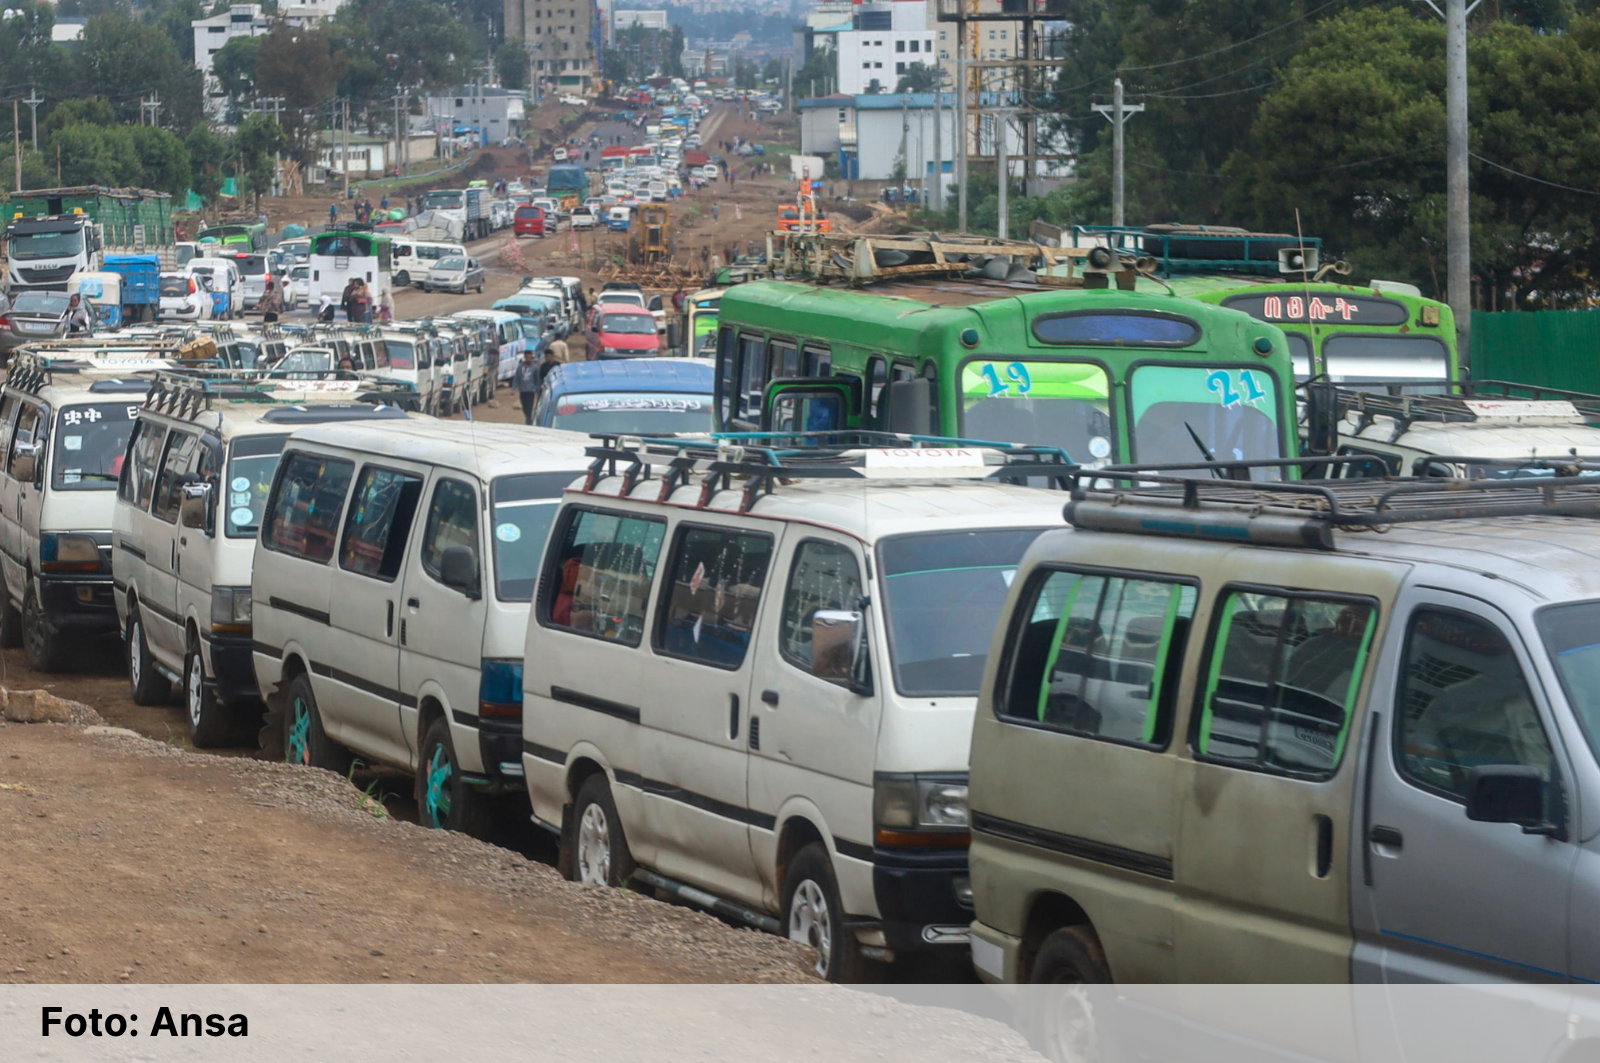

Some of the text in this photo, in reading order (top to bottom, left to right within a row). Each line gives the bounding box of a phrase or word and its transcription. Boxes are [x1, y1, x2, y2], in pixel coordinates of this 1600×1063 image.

[981, 361, 1032, 399] 19
[1206, 368, 1266, 410] 21
[876, 447, 973, 458] TOYOTA
